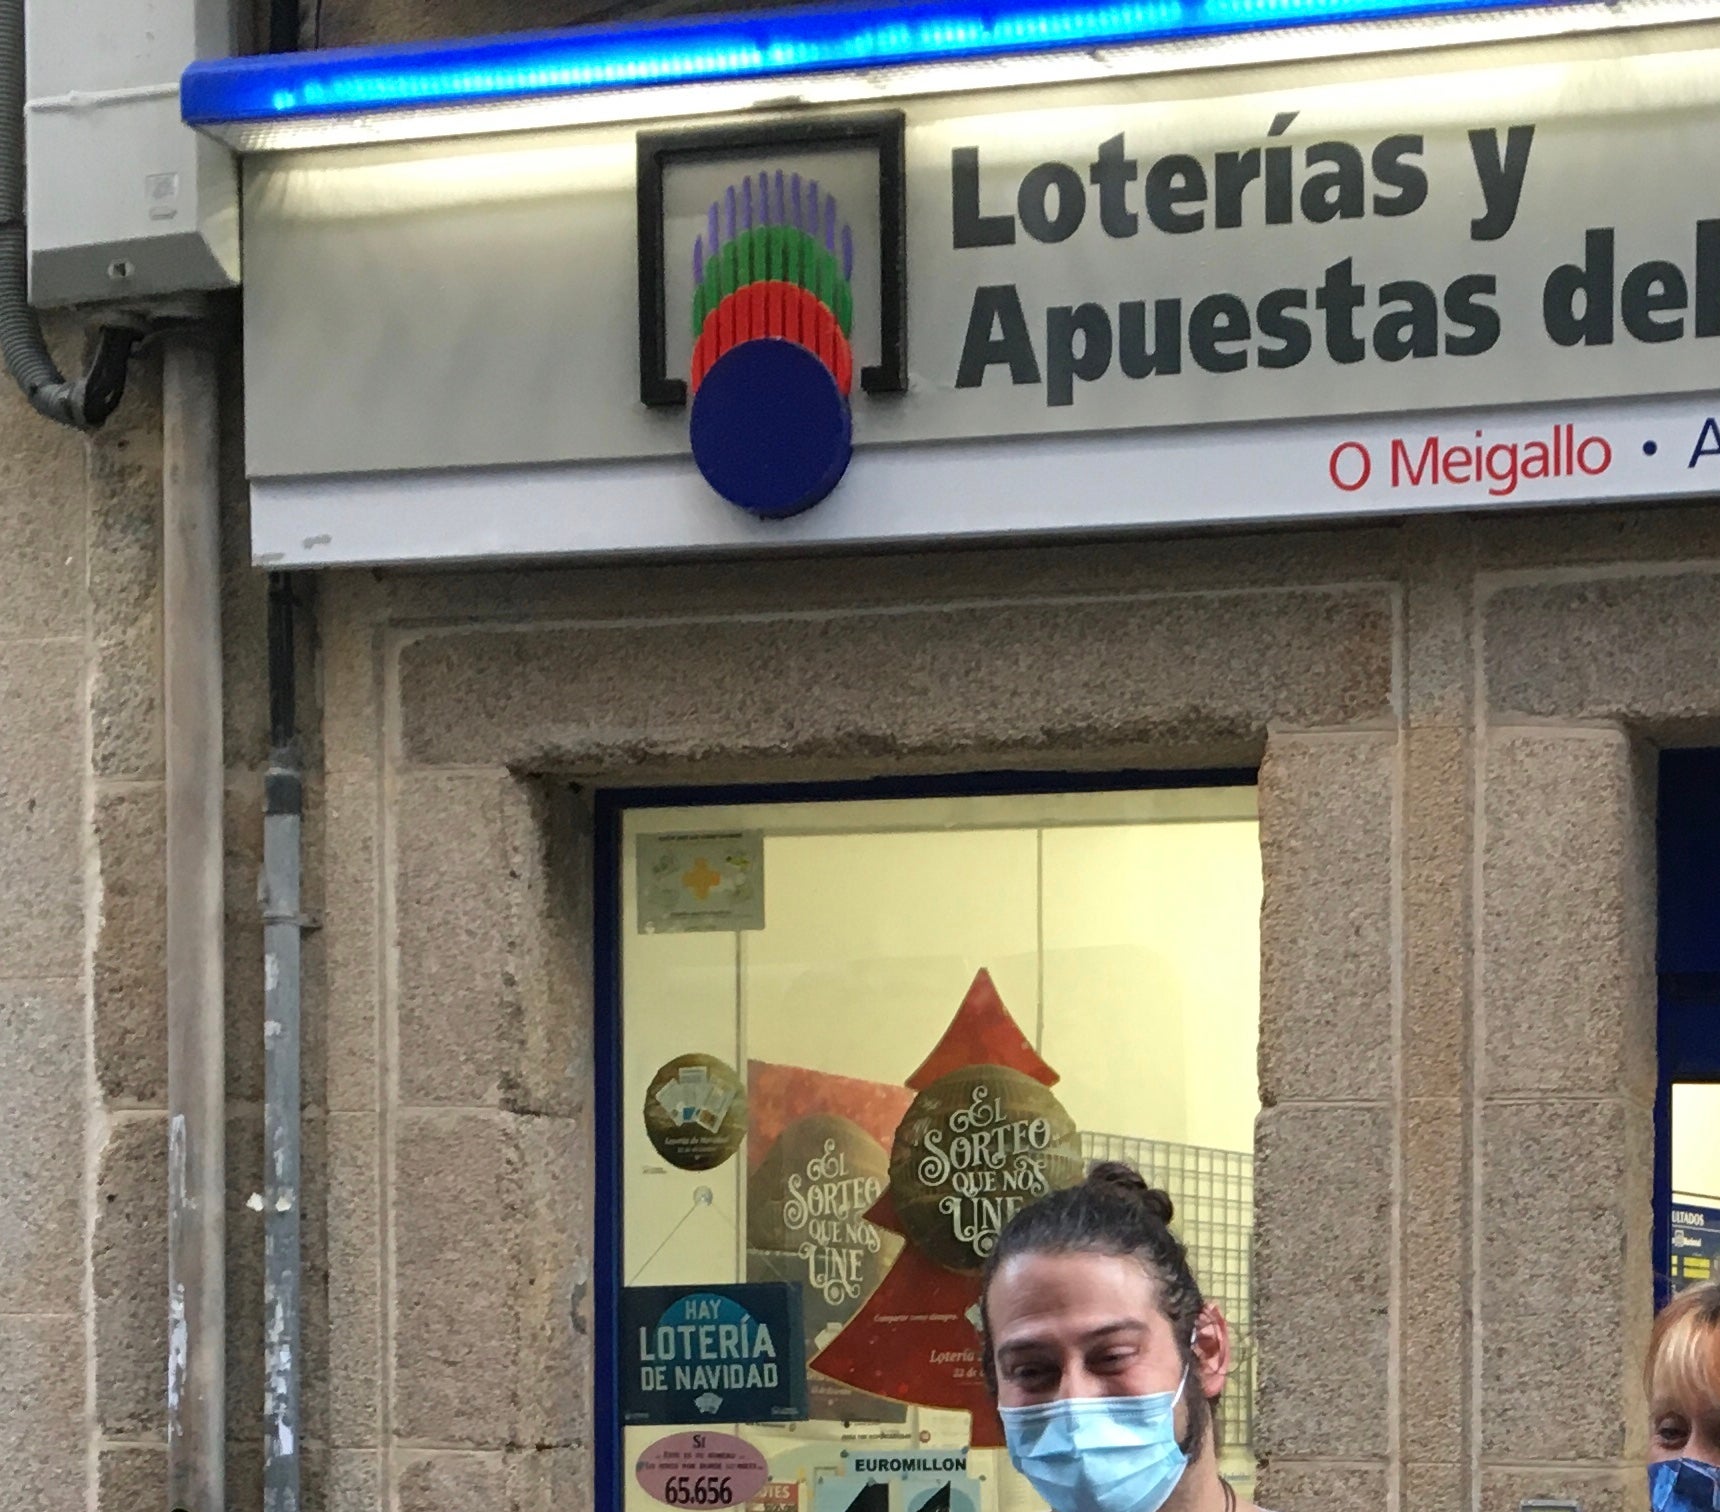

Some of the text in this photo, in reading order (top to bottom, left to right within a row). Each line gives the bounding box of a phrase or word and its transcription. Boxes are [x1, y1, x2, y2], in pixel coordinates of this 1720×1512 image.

[952, 111, 1536, 248] Loterías y
[955, 257, 1502, 406] Apuestas
[1329, 423, 1612, 496] O Meigallo
[950, 1085, 1007, 1132] EL
[918, 1117, 1050, 1187] SORTEO
[952, 1155, 1049, 1198] QUE NOS
[809, 1219, 843, 1247] QUE
[800, 1241, 865, 1306] UNE
[685, 1300, 721, 1320] HAY
[640, 1313, 776, 1361] LOTERÍA
[641, 1363, 778, 1391] DE NAVIDAD
[855, 1458, 967, 1472] EUROMILLON
[664, 1475, 733, 1505] 65.656
